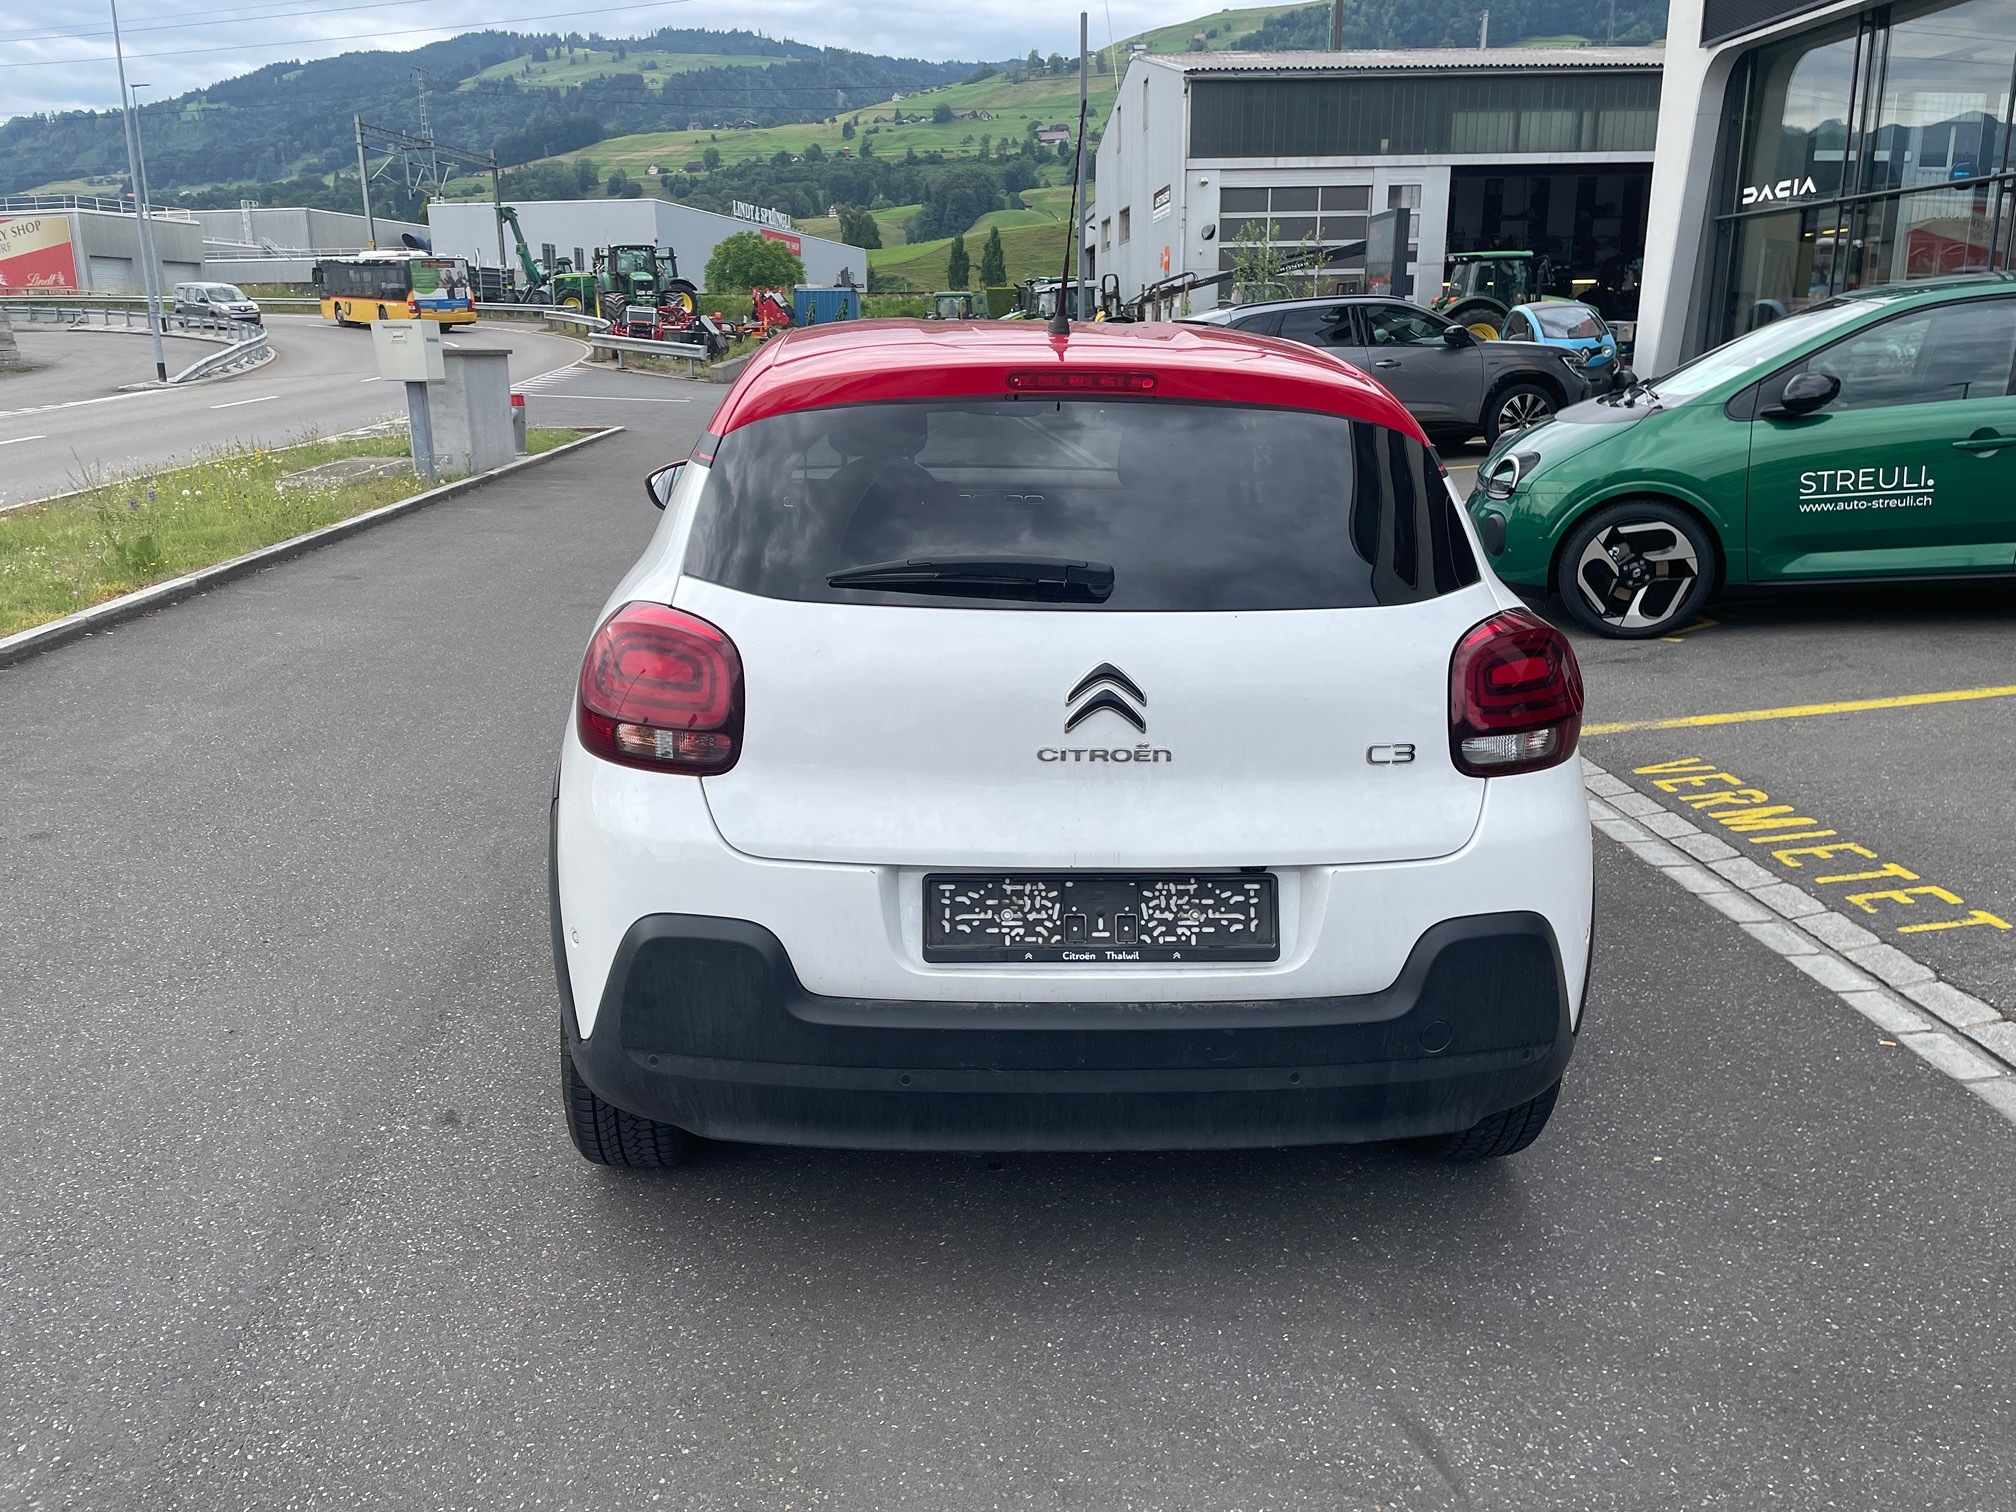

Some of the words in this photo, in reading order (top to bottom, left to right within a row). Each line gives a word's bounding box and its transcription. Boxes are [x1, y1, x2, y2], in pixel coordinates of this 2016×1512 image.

[1742, 176, 1817, 205] DACIA
[733, 199, 755, 220] LINDT
[11, 220, 41, 238] SHOP
[26, 272, 57, 286] Lindt
[1799, 495, 1933, 513] www.auto-streuli.ch
[1366, 743, 1416, 765] C3
[1632, 757, 2014, 934] VERMIETET
[1062, 951, 1096, 960] Citroën
[1105, 951, 1140, 960] Thalwil
